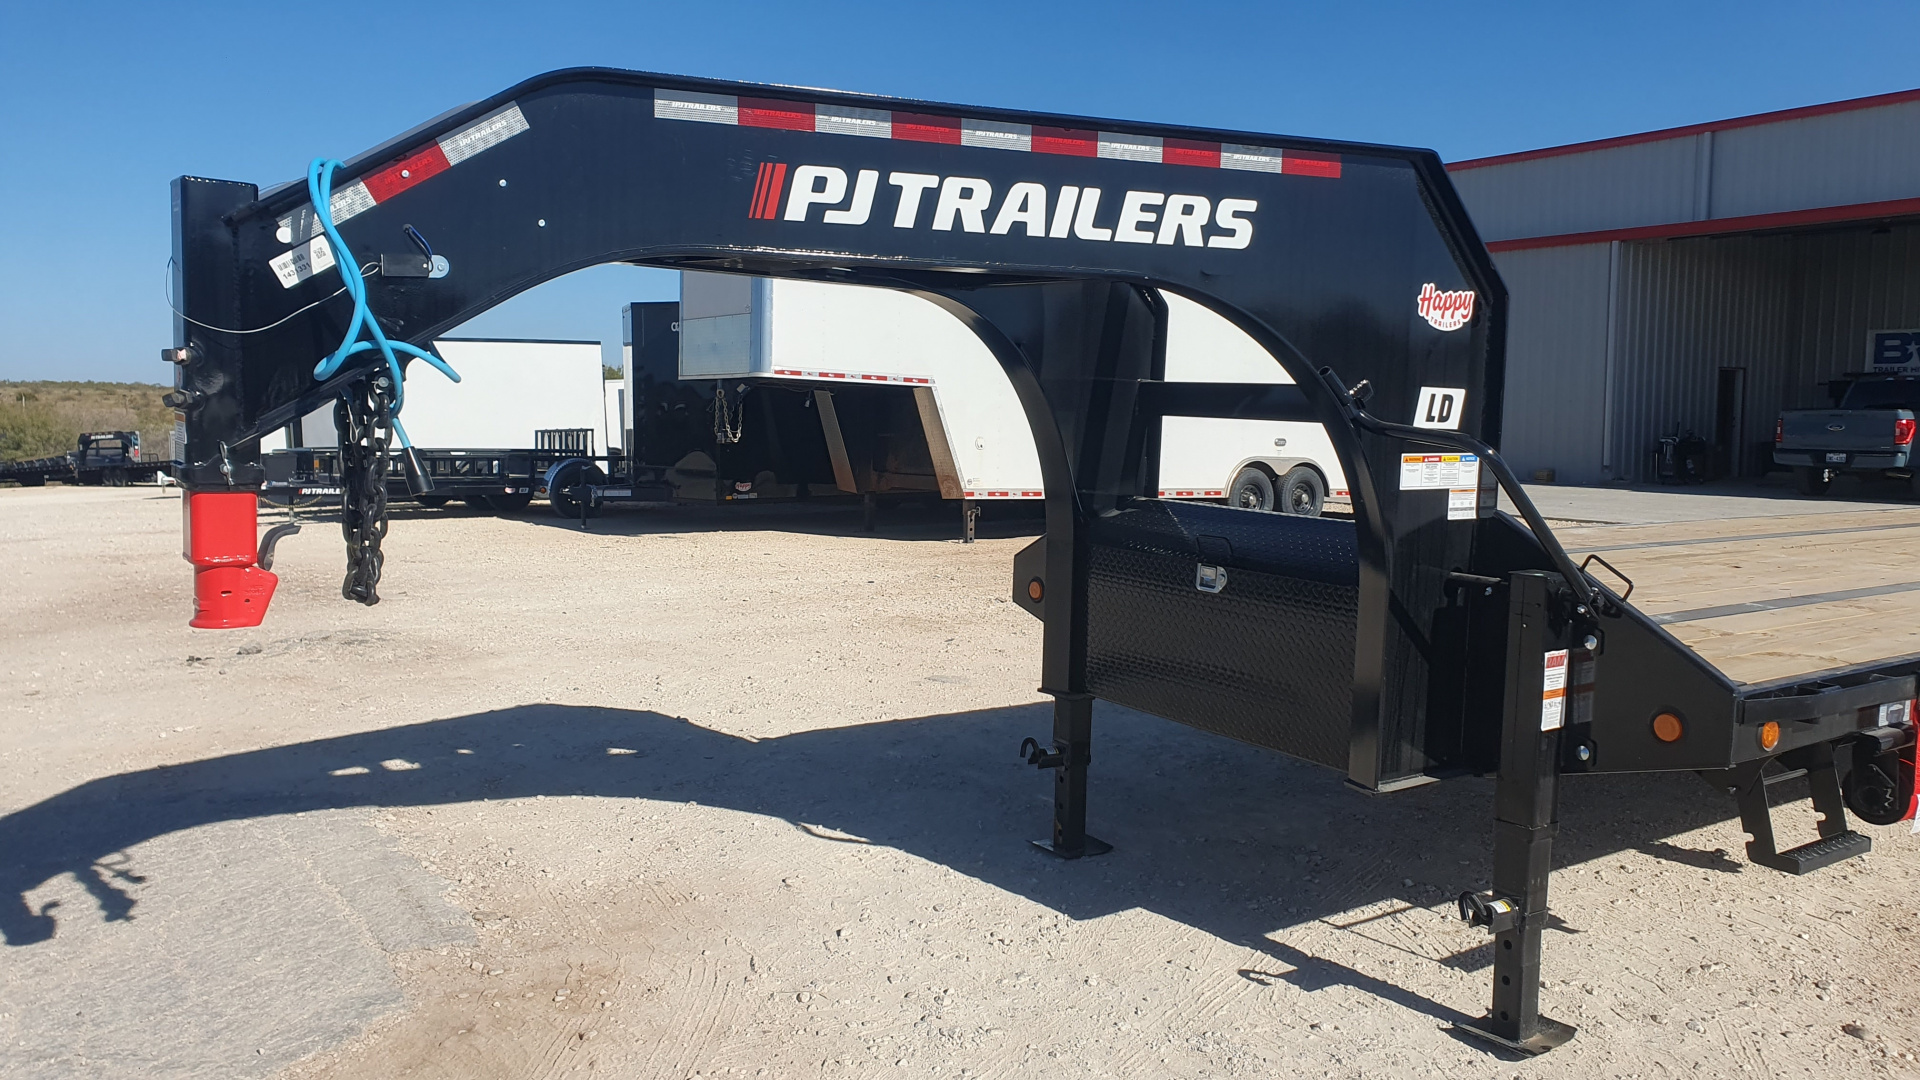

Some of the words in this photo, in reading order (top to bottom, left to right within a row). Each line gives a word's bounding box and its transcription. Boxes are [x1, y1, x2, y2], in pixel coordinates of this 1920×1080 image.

[888, 172, 1258, 250] TRAILERS
[1419, 285, 1474, 320] Happy
[1430, 316, 1462, 328] TRAILERS
[1425, 393, 1454, 423] LD
